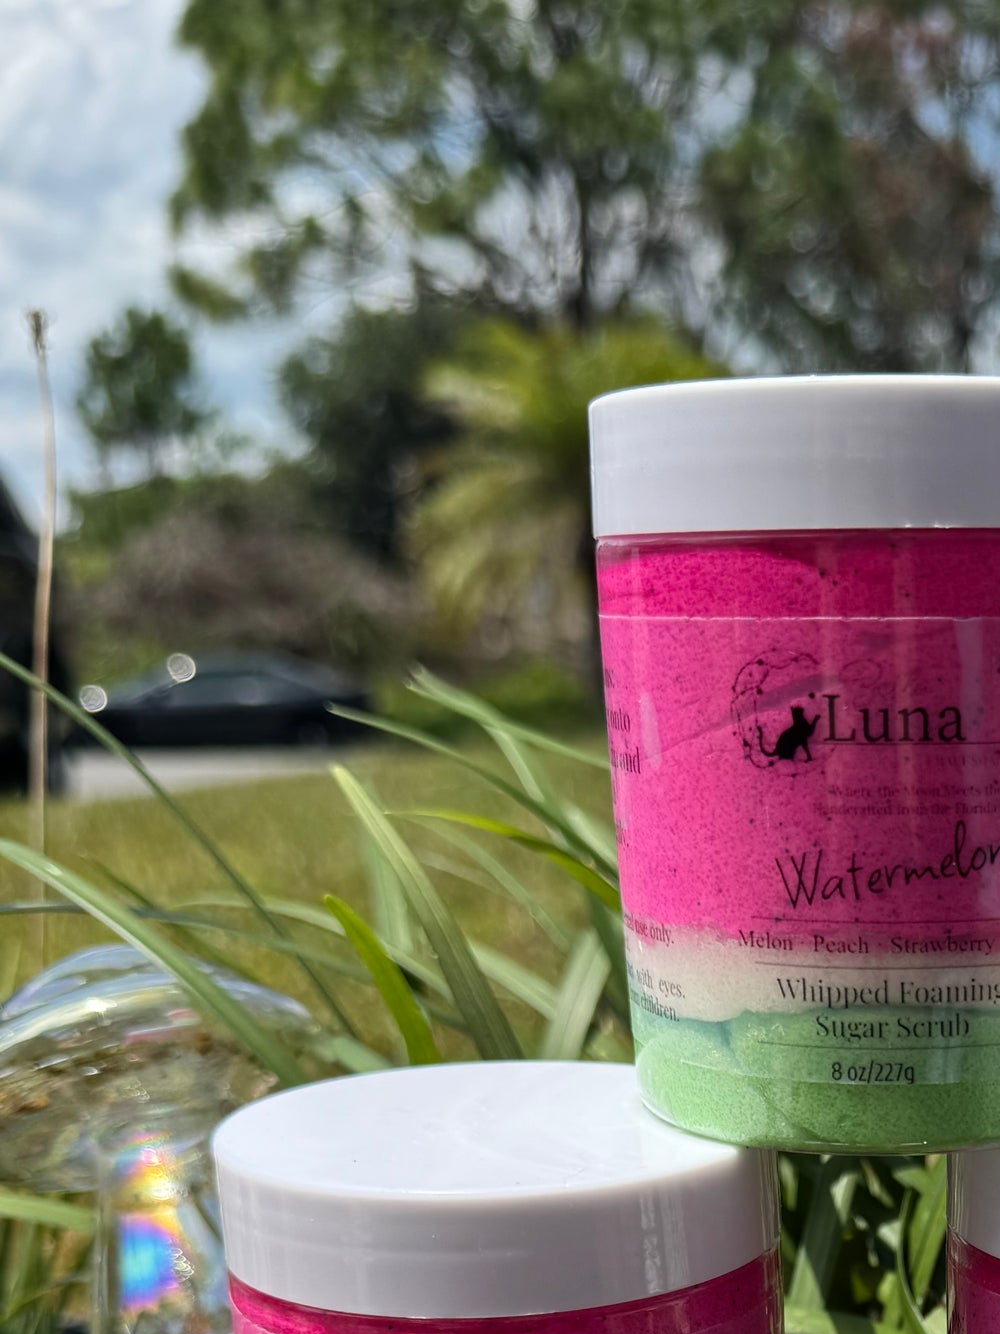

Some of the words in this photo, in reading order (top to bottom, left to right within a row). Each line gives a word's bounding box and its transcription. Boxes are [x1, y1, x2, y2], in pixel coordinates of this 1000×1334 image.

[822, 694, 967, 743] Luna
[737, 928, 794, 951] Melon
[812, 934, 869, 954] Peach
[890, 935, 995, 956] Strawberry
[658, 978, 686, 998] eyes.
[776, 977, 889, 1009] Whipped
[815, 1014, 890, 1042] Sugar
[896, 1012, 970, 1039] Scrub
[831, 1062, 842, 1081] 8
[847, 1059, 915, 1085] oz/227g
